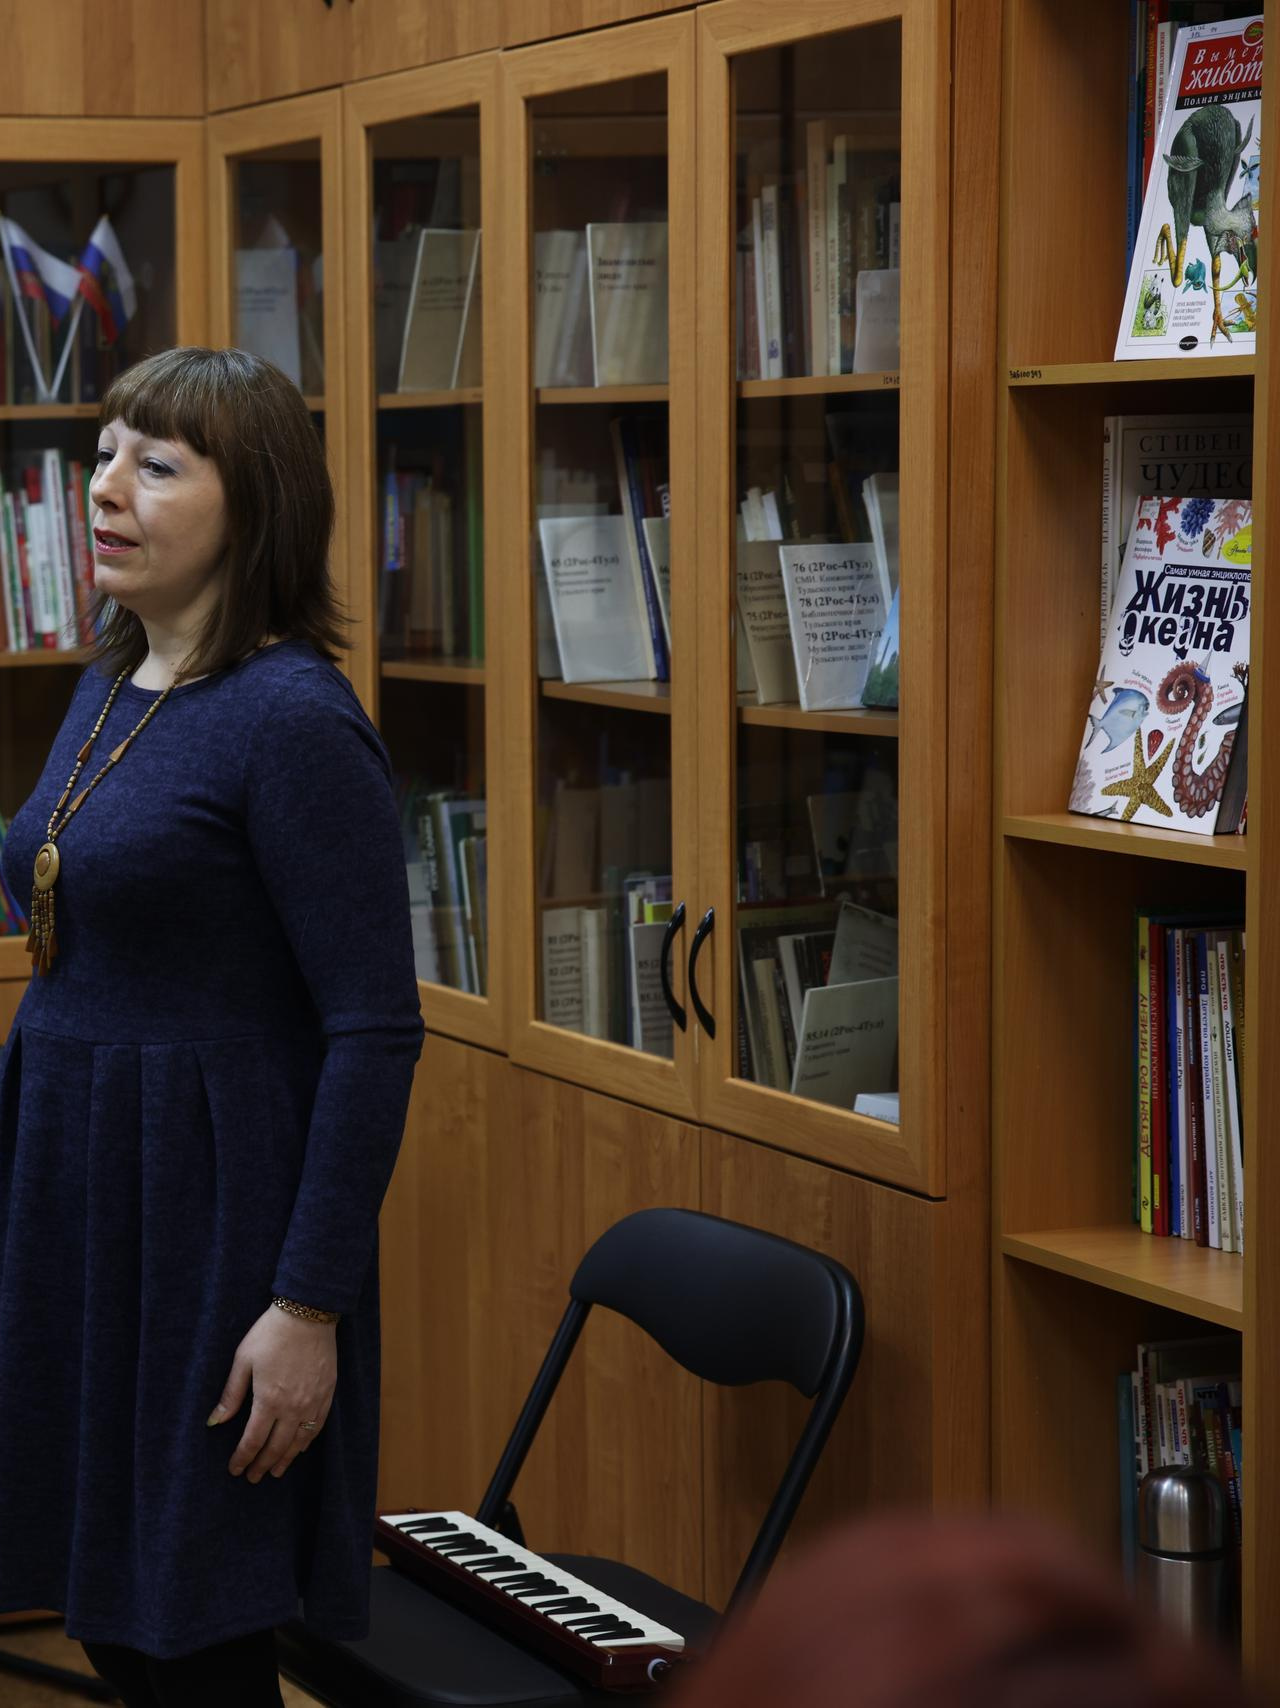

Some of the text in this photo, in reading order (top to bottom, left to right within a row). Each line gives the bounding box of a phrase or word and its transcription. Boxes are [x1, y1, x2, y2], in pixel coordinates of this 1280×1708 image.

[1139, 433, 1241, 453] СТИВЕН
[793, 560, 873, 573] 76 (2Рос-4Тул)
[1164, 564, 1187, 577] Самая
[1187, 567, 1210, 579] умная
[800, 593, 880, 608] 78 (2Рос-4Тул)
[1126, 569, 1250, 622] Жизнь
[806, 629, 882, 643] 79 (2Рос-4Тул
[1201, 1000, 1210, 1039] Детство
[1138, 993, 1152, 1158] ДЕТЯМ ПРО ГИГИЕНУ
[1204, 1055, 1212, 1100] кораблях
